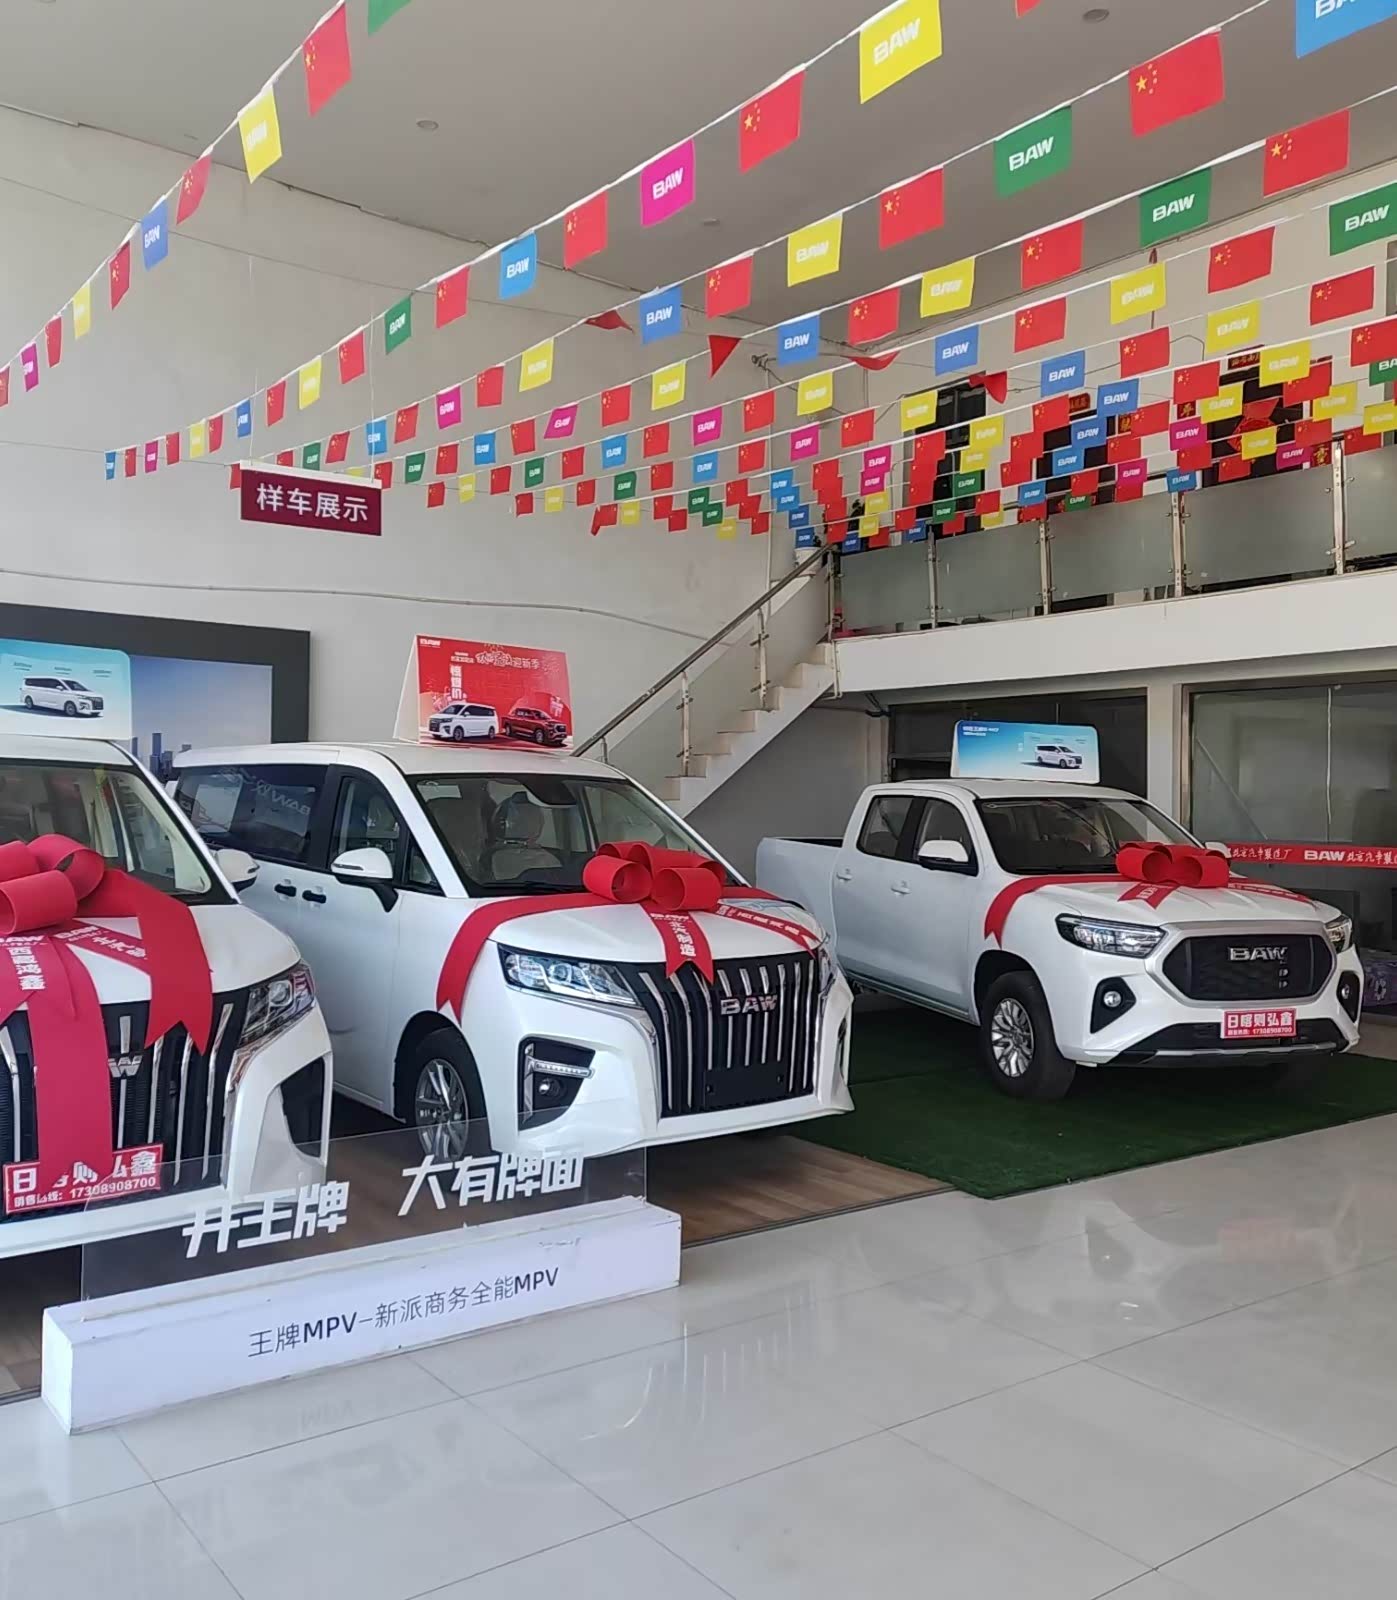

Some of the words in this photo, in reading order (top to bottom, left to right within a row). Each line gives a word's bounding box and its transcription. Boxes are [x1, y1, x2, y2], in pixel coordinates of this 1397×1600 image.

[873, 18, 920, 64] BAW
[1009, 137, 1053, 171] BAW
[653, 168, 683, 199] BAW
[1153, 194, 1194, 222] BAW
[1345, 205, 1389, 231] BAW
[507, 258, 529, 278] BAW
[390, 313, 405, 334] BAW
[647, 306, 672, 325] BAW
[784, 333, 809, 349] BAW
[942, 342, 969, 359] BAW
[1049, 367, 1075, 382] BAW
[1104, 392, 1129, 404] BAW
[698, 421, 715, 432] BAW
[1077, 428, 1099, 439] BAW
[1176, 428, 1199, 439] BAW
[256, 482, 369, 523] 样车展示
[1304, 850, 1345, 861] BAW
[1229, 946, 1288, 961] BAW
[720, 994, 779, 1016] BAW
[69, 1176, 156, 1199] 17308908700
